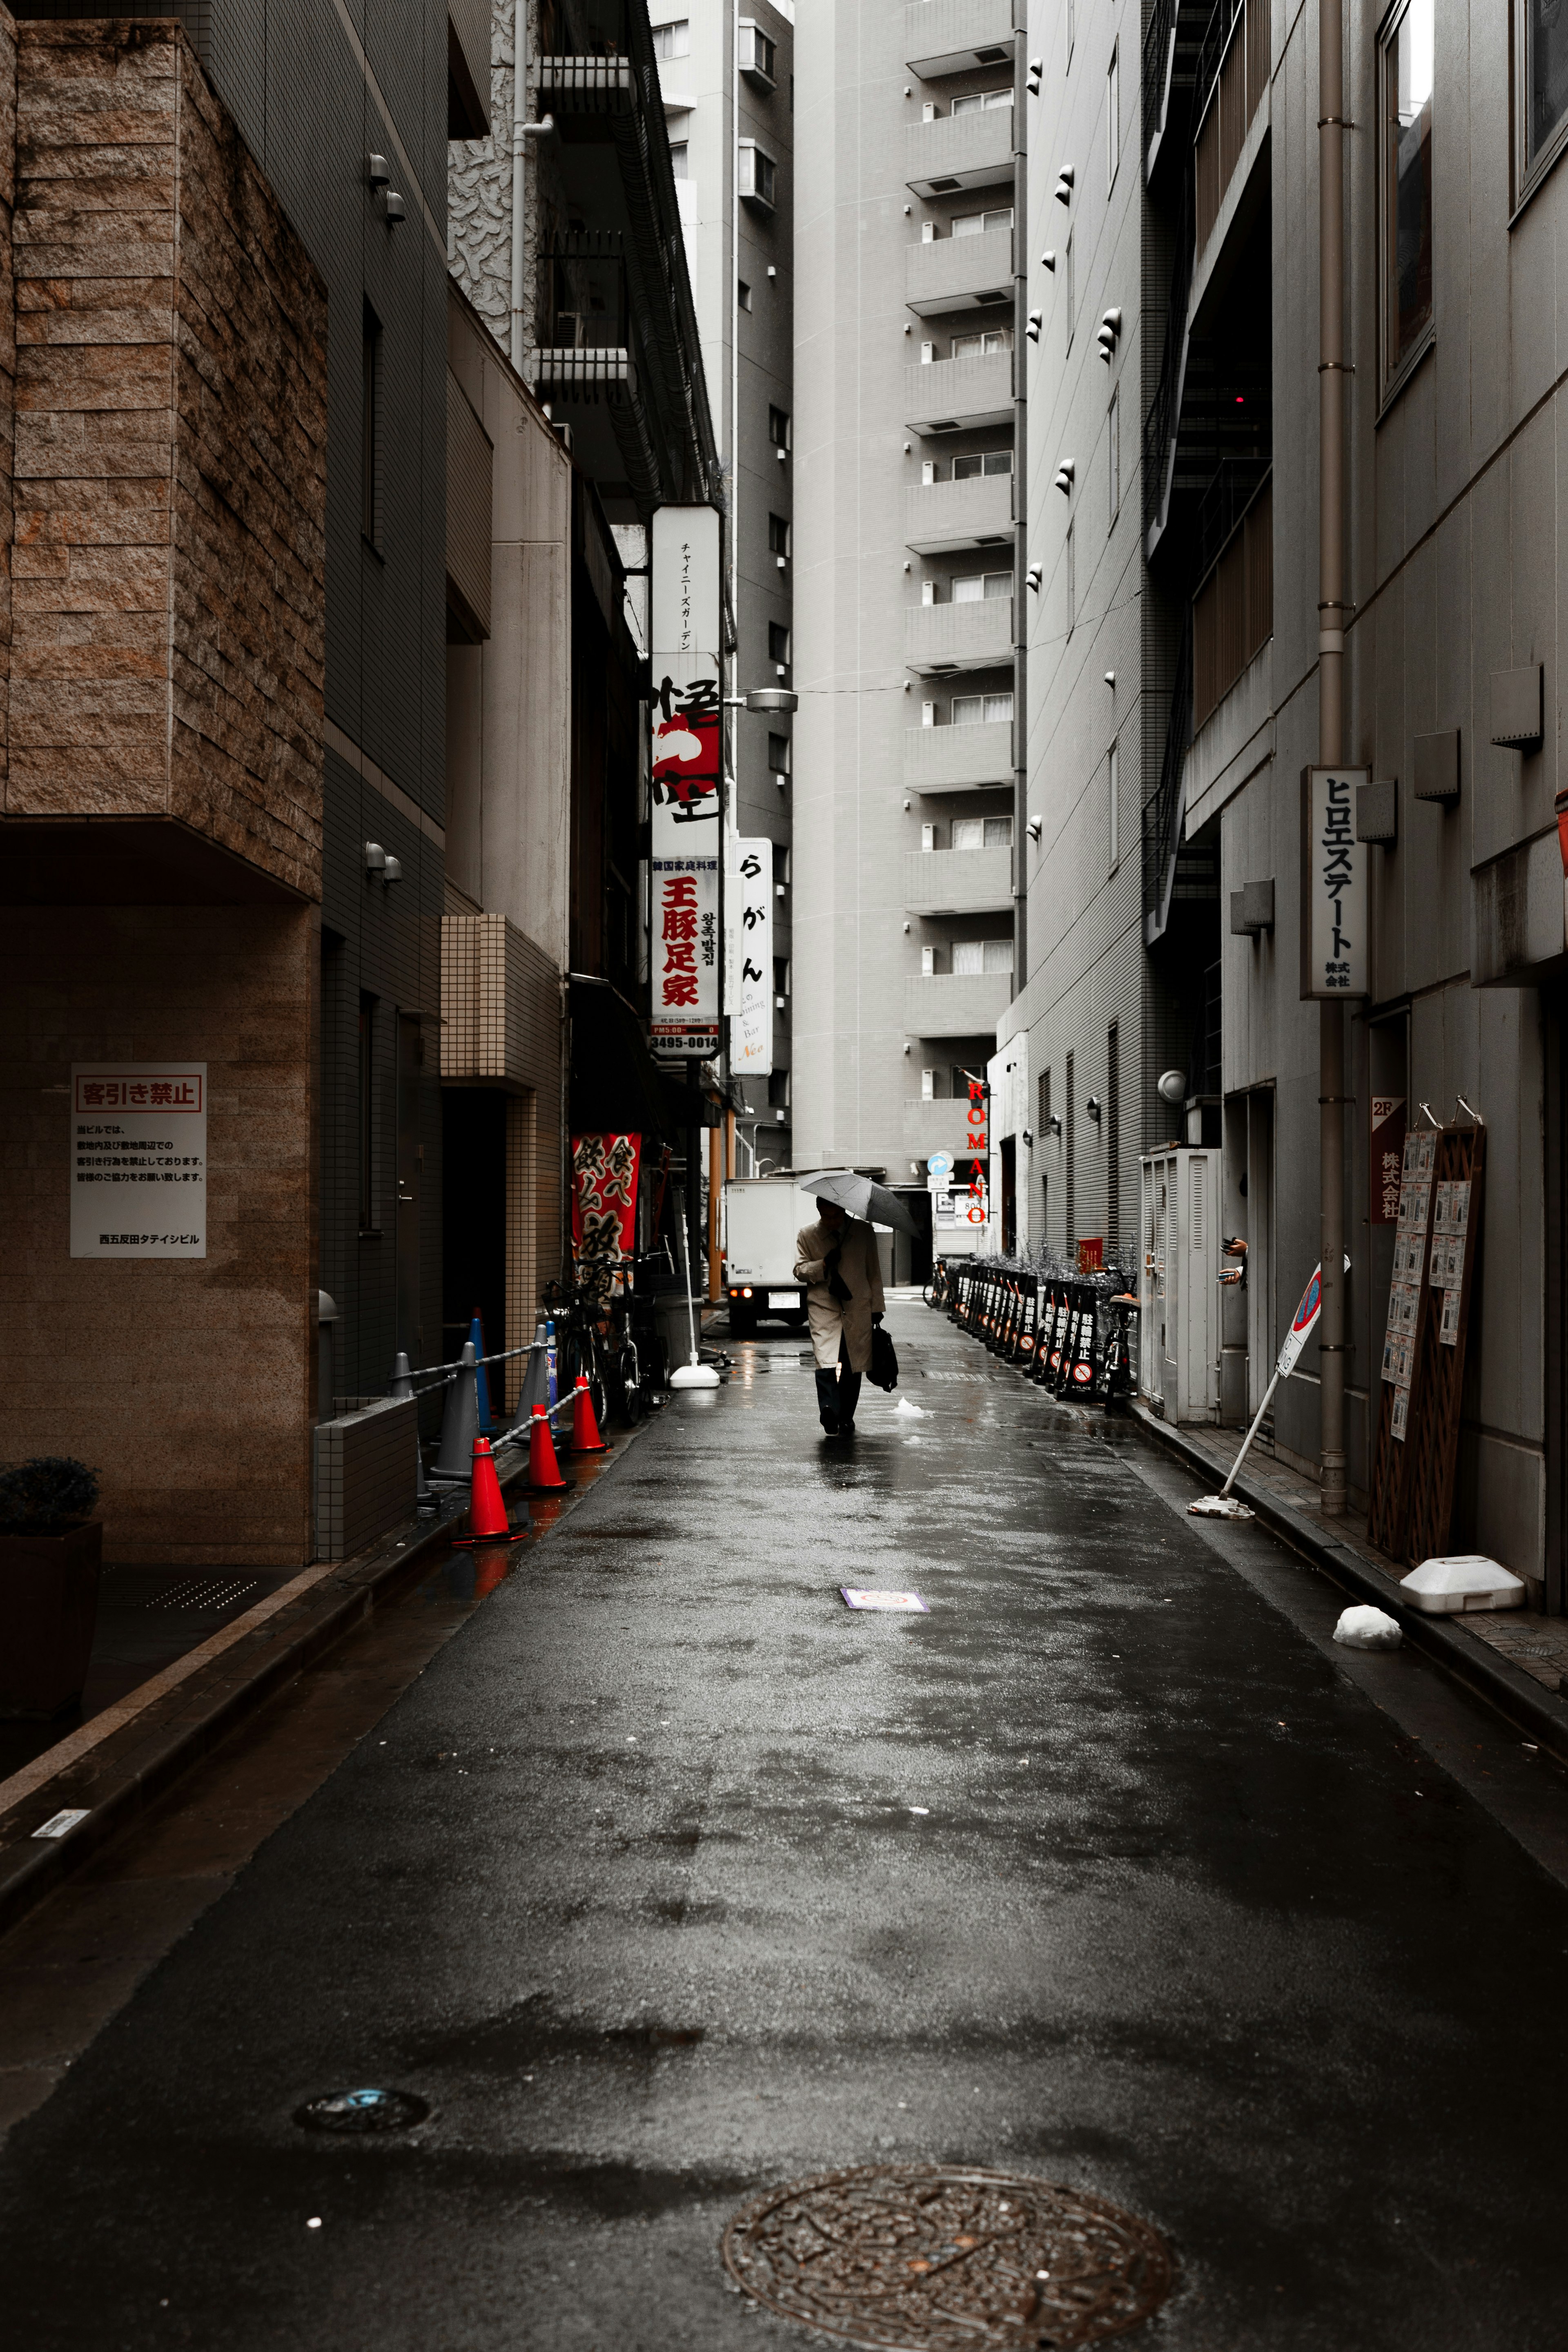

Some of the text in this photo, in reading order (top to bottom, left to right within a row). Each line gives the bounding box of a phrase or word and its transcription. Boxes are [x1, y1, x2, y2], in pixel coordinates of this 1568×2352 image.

[681, 543, 691, 651] チャイニーズガーデン
[653, 861, 717, 871] 韓国家庭料理
[1322, 778, 1354, 959] ヒロエステート
[739, 854, 765, 982] らがん
[662, 876, 699, 1006] 王豚足家
[701, 912, 716, 966] 왕족발집
[744, 1026, 760, 1039] Bar
[652, 1037, 718, 1048] 3495-0014
[738, 1043, 763, 1061] Neo
[83, 1083, 195, 1105] 客引き禁止
[1374, 1101, 1392, 1116] 2F
[77, 1126, 125, 1135] 当ビルでは、
[77, 1141, 174, 1150] 敷地内及び敷地周辺での
[967, 1083, 986, 1223] ROMANO
[77, 1157, 203, 1166] 客引き行為を禁止しております。
[77, 1173, 203, 1182] 皆様のご協力をお願い致します。
[1382, 1152, 1400, 1219] 株式会社
[99, 1234, 200, 1244] 西五反田タテイシビル
[1079, 1313, 1093, 1360] 駐輪禁止
